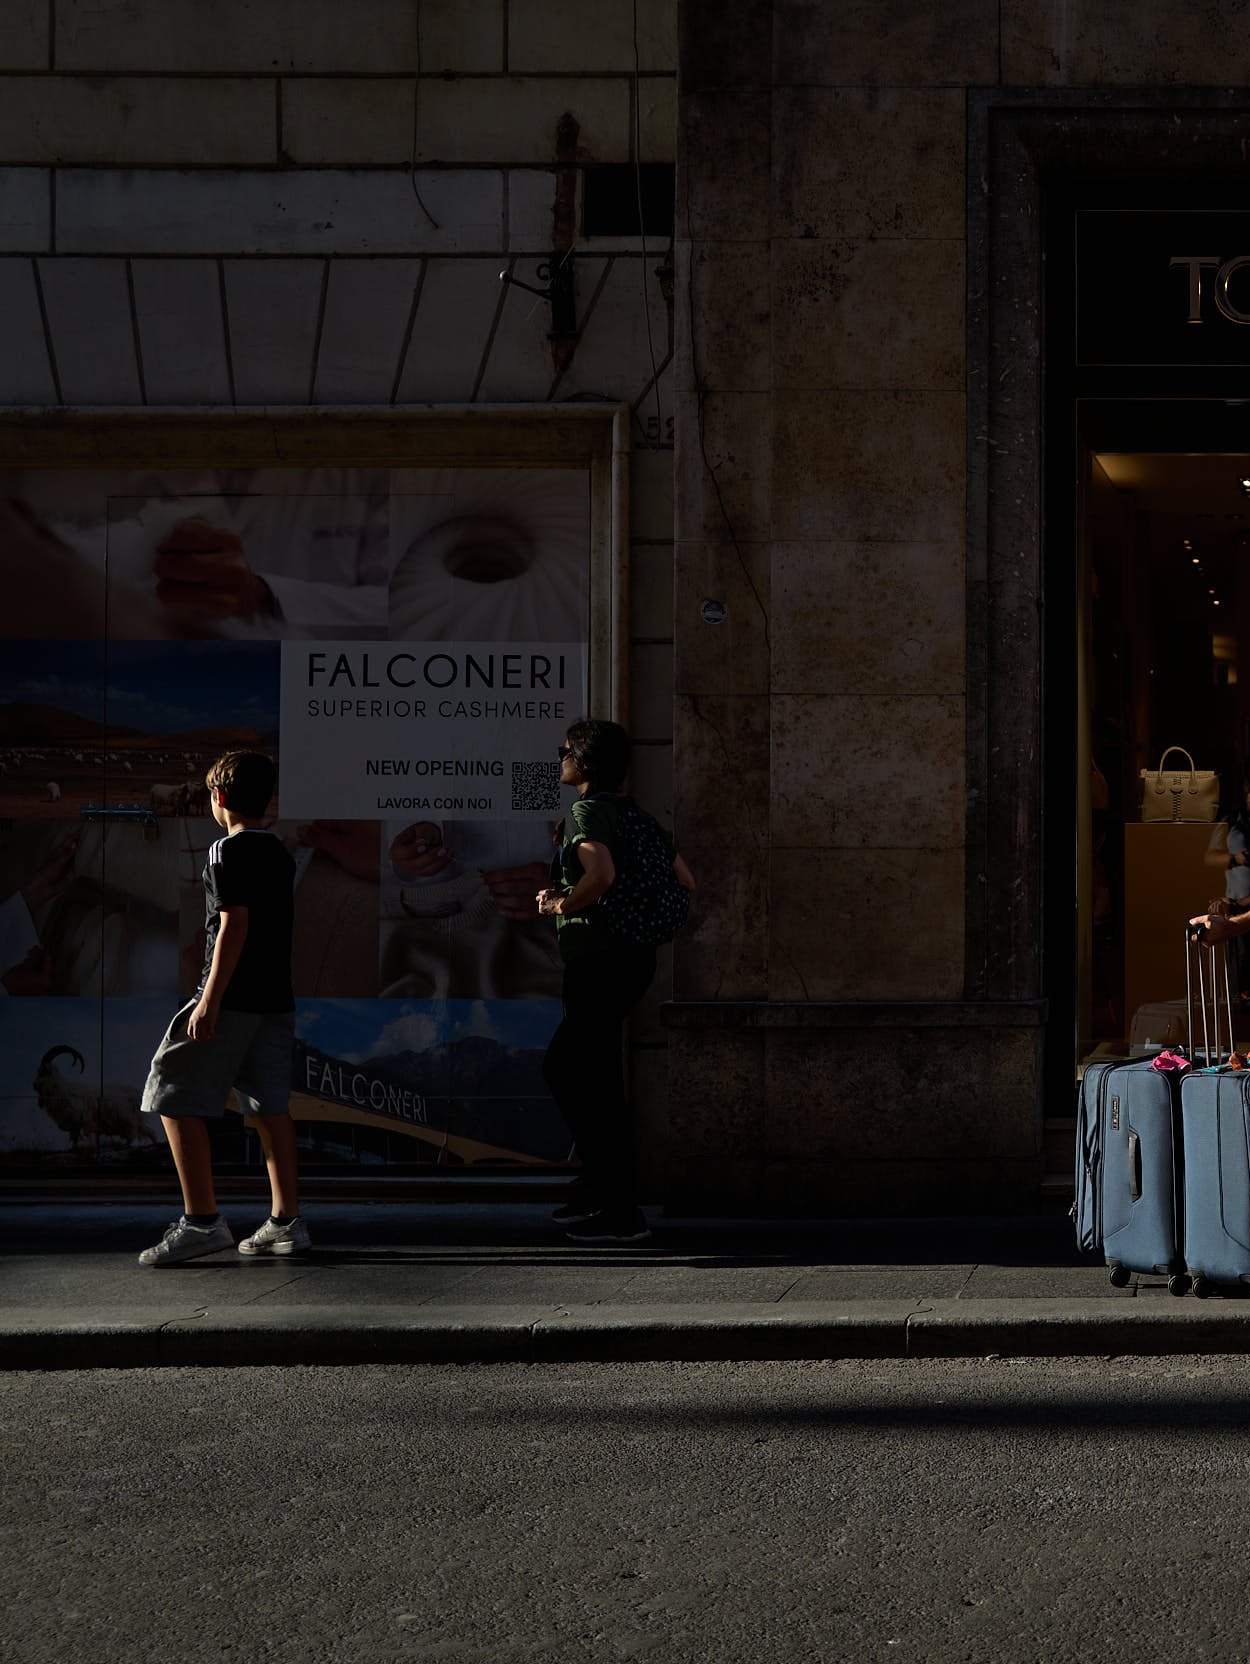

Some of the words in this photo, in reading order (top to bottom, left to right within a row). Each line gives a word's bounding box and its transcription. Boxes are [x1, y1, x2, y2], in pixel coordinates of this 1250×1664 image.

[308, 653, 566, 689] FALCONERI
[307, 699, 427, 718] SUPERIOR
[438, 700, 566, 719] CASHMERE
[366, 760, 411, 776] NEW
[415, 760, 504, 777] OPENING
[377, 797, 431, 809] LAVORA
[433, 798, 465, 810] CON
[467, 798, 492, 810] NOI
[305, 1055, 428, 1123] FALCONERI
